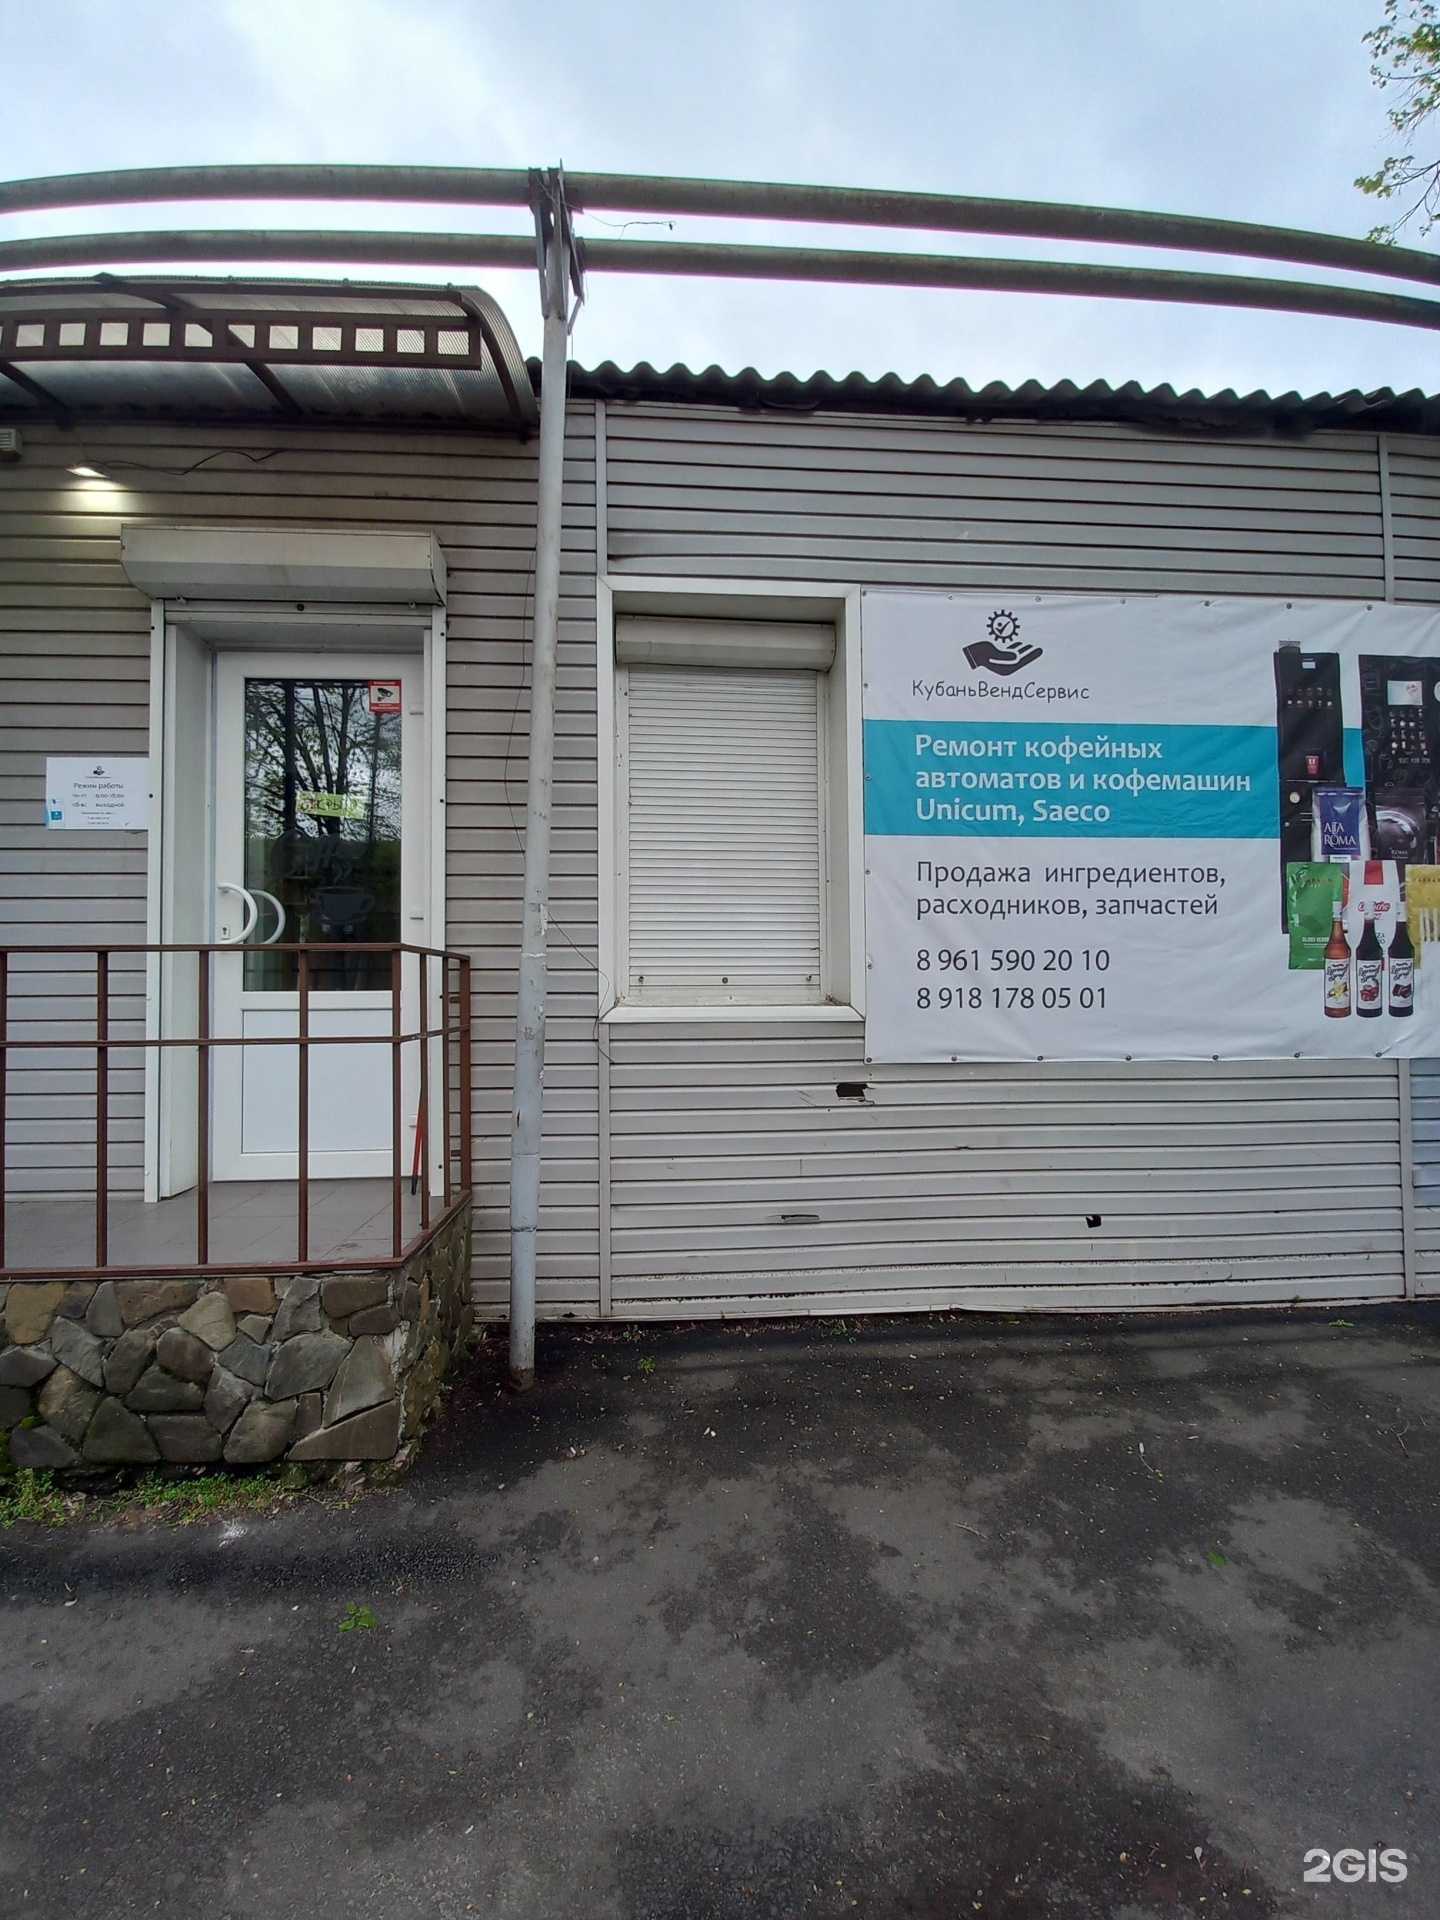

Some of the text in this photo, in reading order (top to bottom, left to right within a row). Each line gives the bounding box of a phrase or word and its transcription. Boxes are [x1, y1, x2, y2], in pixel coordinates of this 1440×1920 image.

[912, 680, 1090, 703] КубаньВендСервис
[915, 734, 1163, 764] Ремонт кофейных
[915, 768, 1251, 797] автоматов и кофемашин
[916, 798, 1111, 826] Unicum, Saeco
[1323, 834, 1357, 848] ROMA
[917, 861, 1226, 888] Продажа ингредиентов,
[917, 894, 1218, 920] расходников, запчастей
[916, 949, 1110, 971] 8 961 590 20 10
[916, 987, 1107, 1009] 8 918 178 05 01
